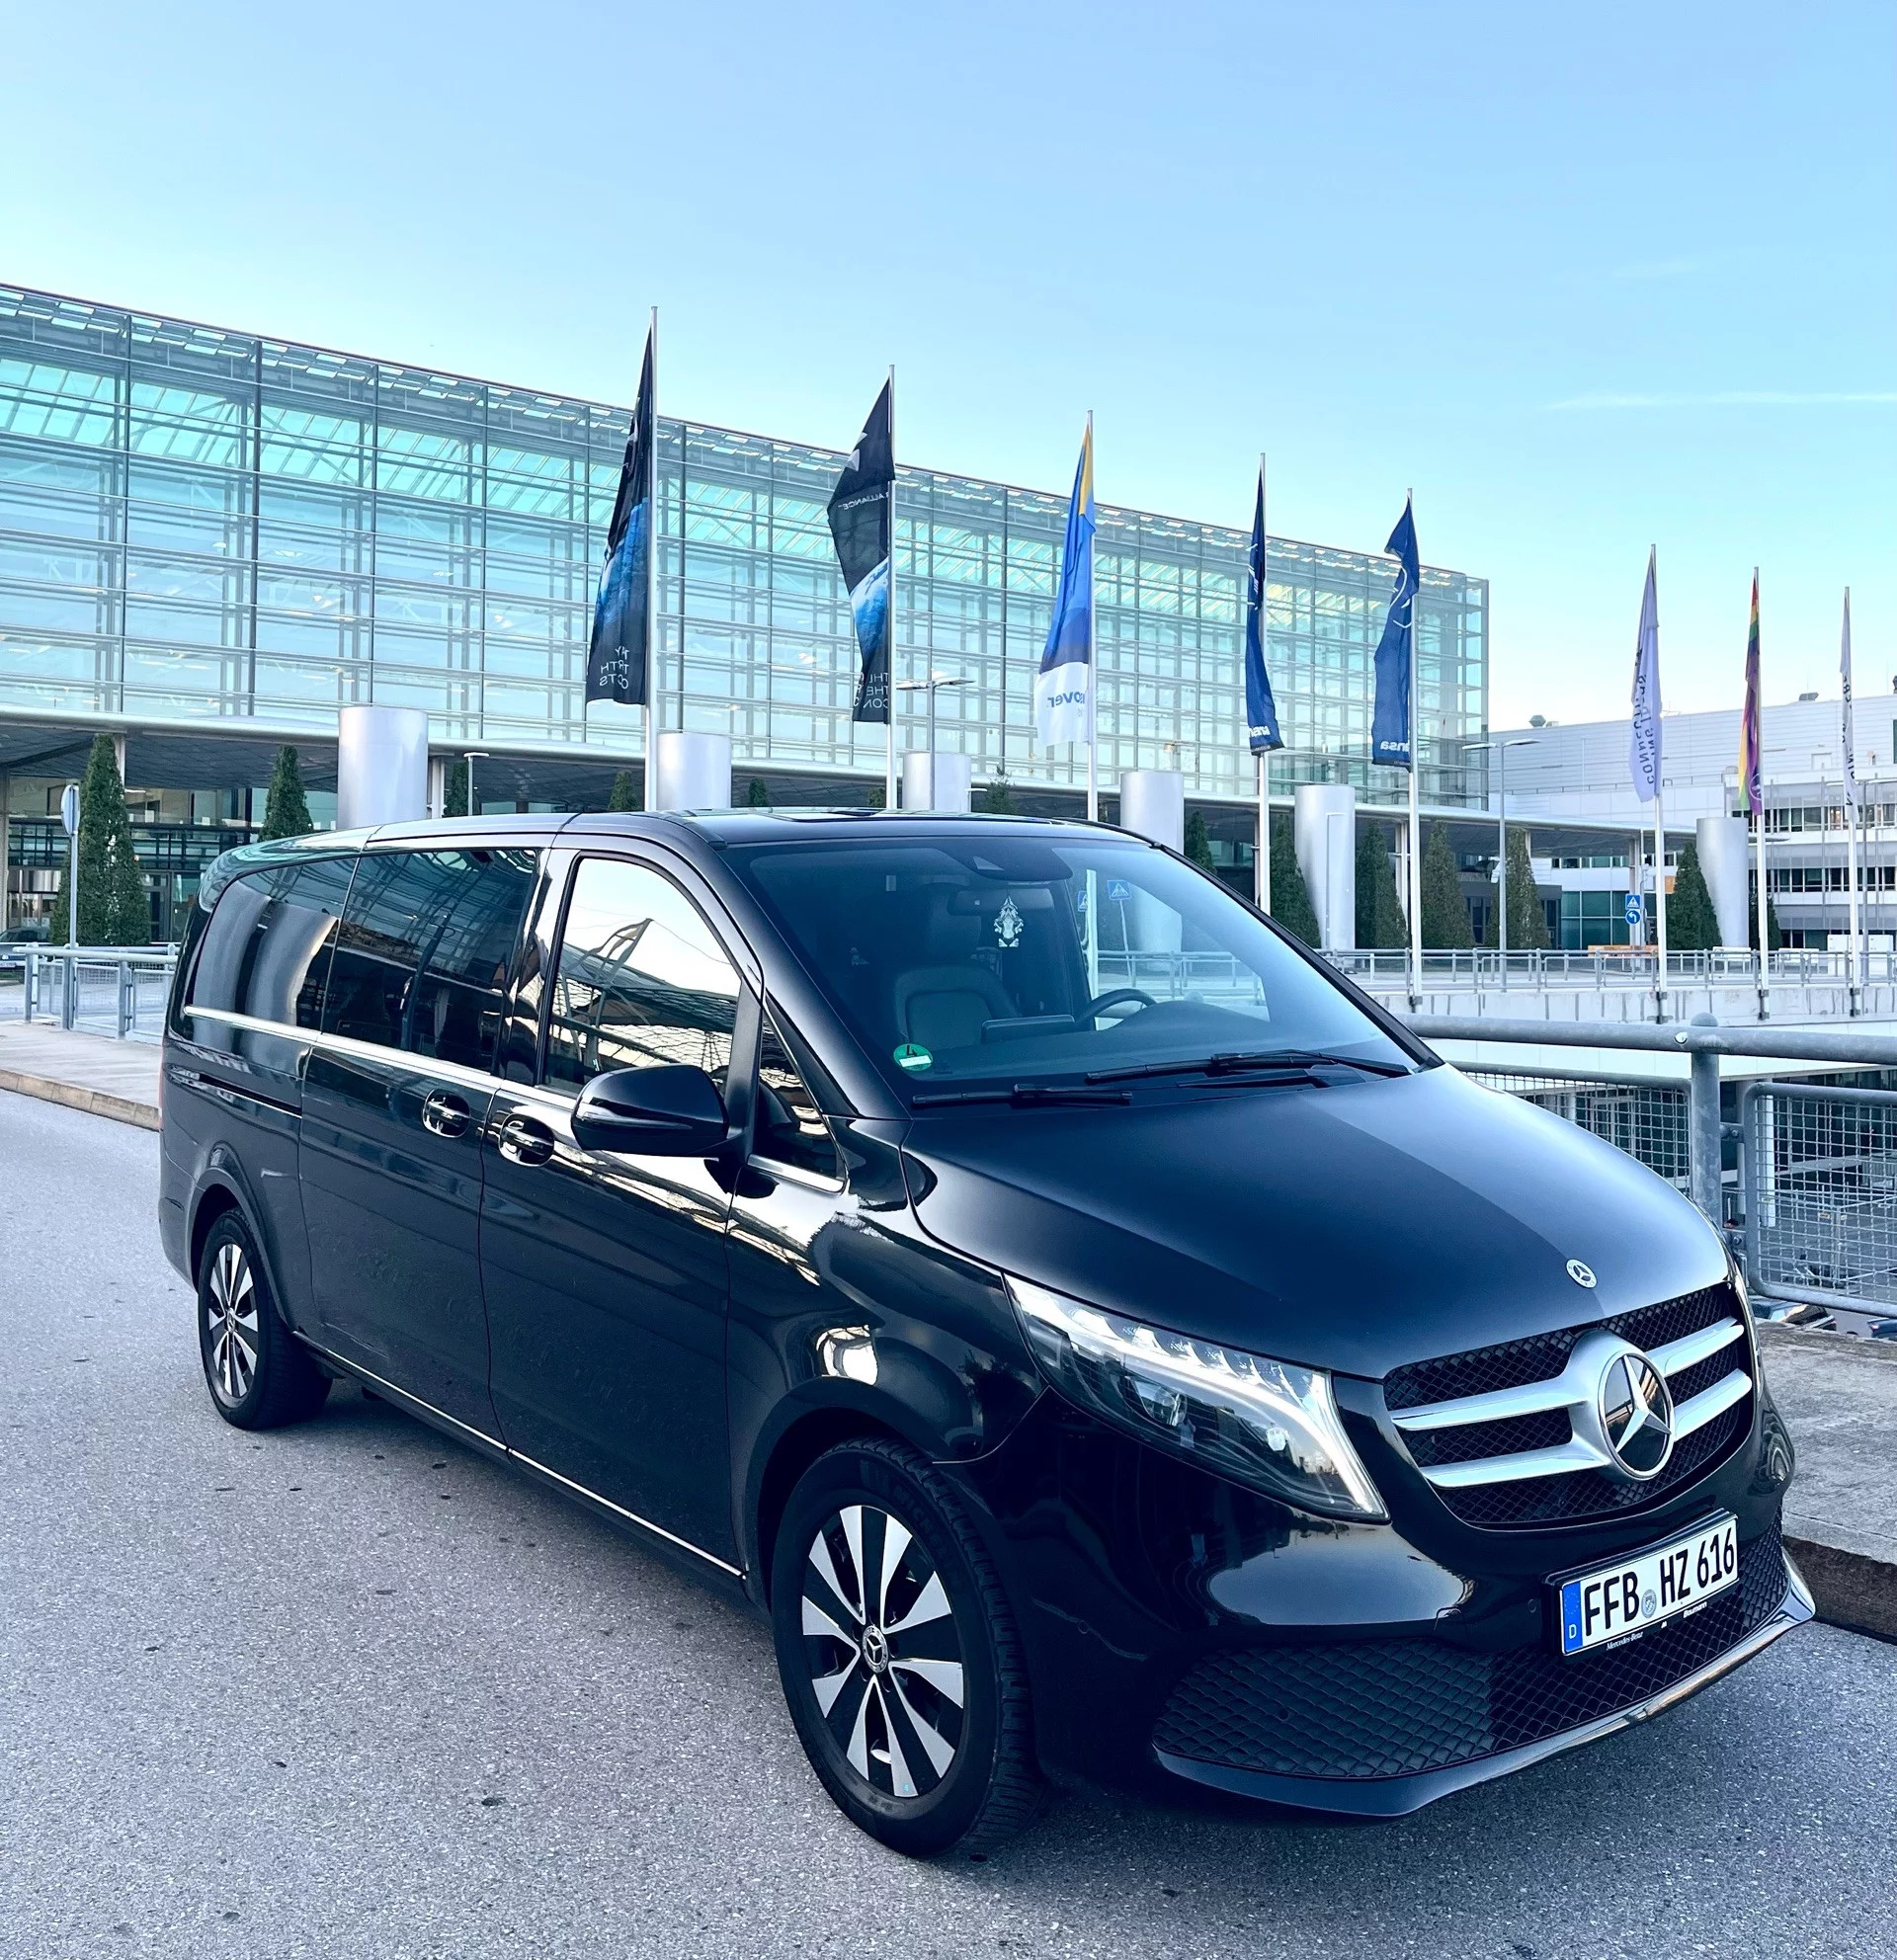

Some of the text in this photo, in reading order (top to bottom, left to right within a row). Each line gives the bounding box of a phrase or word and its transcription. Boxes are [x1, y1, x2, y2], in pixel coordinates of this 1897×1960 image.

[1584, 1527, 1735, 1637] FFB HZ 616
[1568, 1624, 1577, 1640] D
